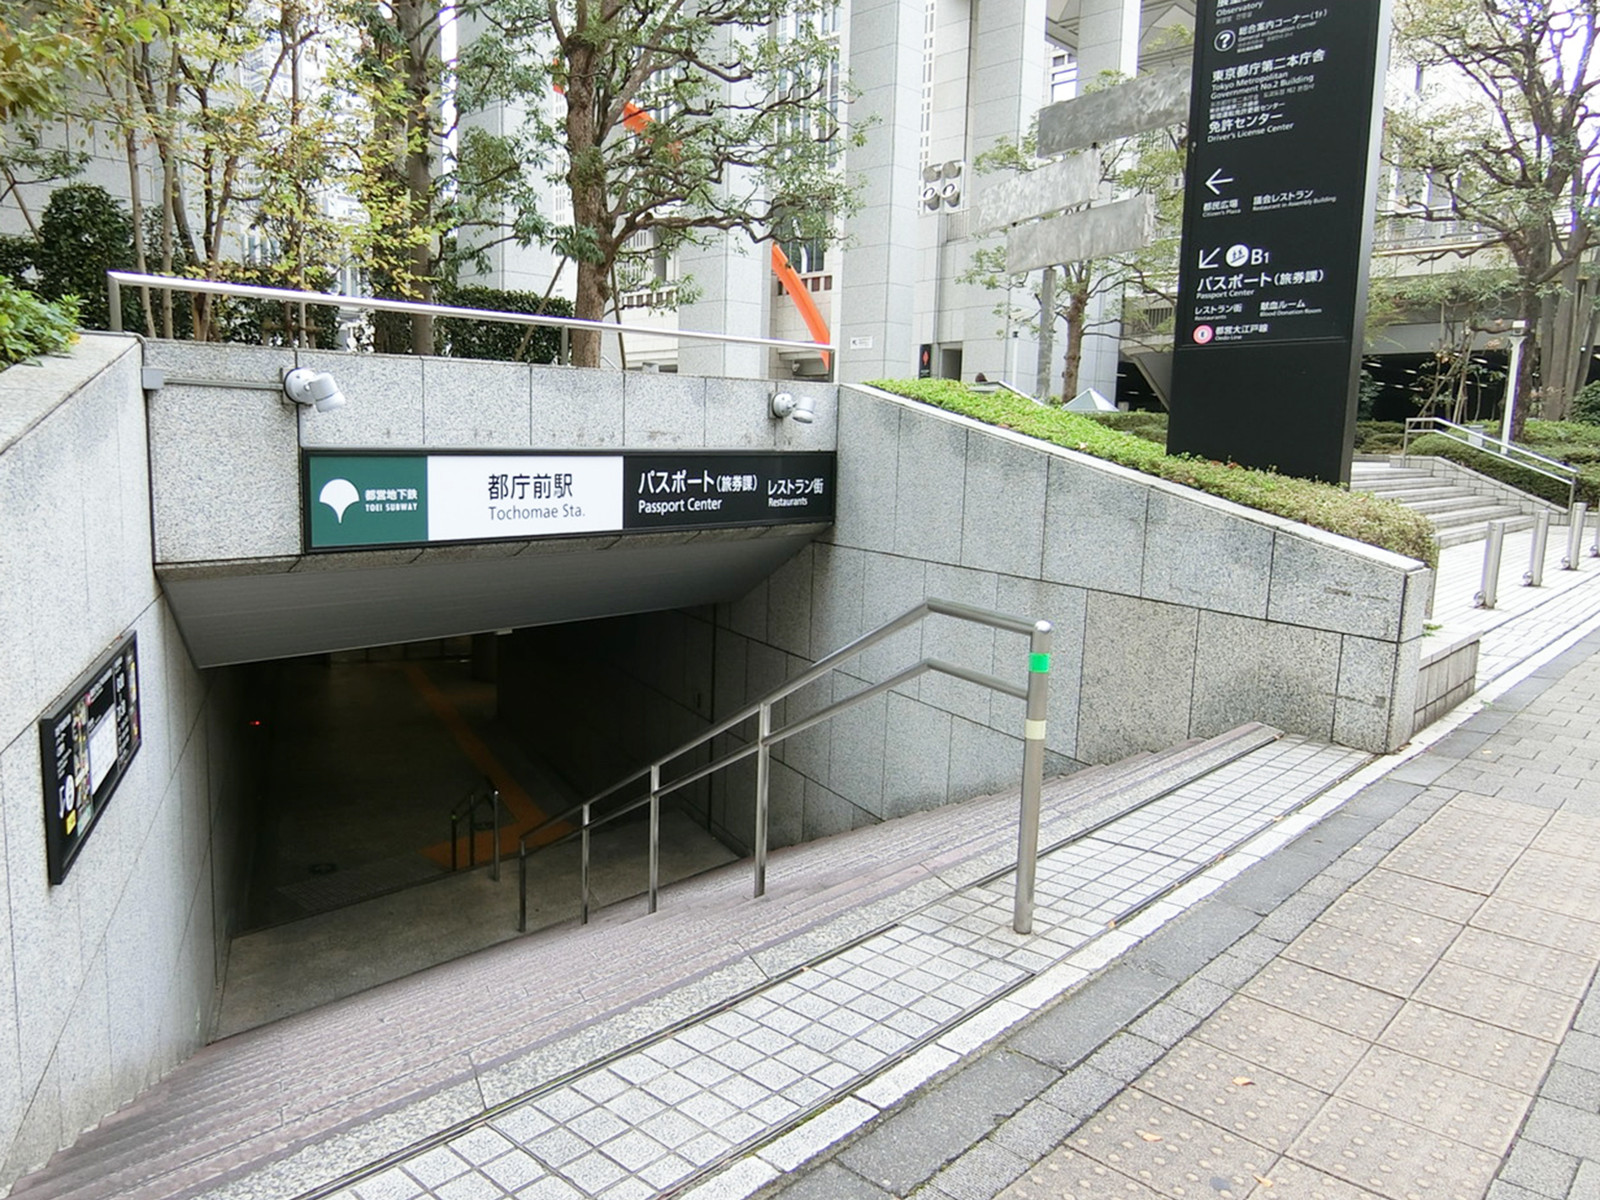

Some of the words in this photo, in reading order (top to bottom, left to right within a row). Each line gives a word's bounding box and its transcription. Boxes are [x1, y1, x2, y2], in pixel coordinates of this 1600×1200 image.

[1215, 1, 1264, 17] Observatory
[1212, 48, 1325, 82] 東京都庁第二本庁舎
[1210, 85, 1259, 100] Government
[1260, 80, 1279, 90] No.2
[1280, 75, 1314, 87] Building
[1211, 82, 1234, 91] Tokyo
[1235, 72, 1289, 87] Metropolitan
[1208, 112, 1283, 134] 免許センター
[1207, 132, 1236, 142] Driver's
[1237, 127, 1265, 138] License
[1267, 122, 1295, 133] Center
[1250, 248, 1269, 265] B1
[1196, 291, 1228, 299] Passport
[1229, 289, 1255, 297] Center
[1195, 303, 1243, 315] レストラン街
[365, 488, 418, 501] 都営地下鉄
[488, 473, 573, 500] 都庁前駅
[768, 478, 824, 495] レストラン街
[365, 503, 383, 512] TOEI
[385, 502, 418, 511] SUBWAY
[638, 499, 685, 516] Passport
[687, 497, 722, 511] Center
[768, 497, 808, 507] Restaurants
[488, 505, 558, 520] Tochomae
[562, 503, 586, 518] Sta.
